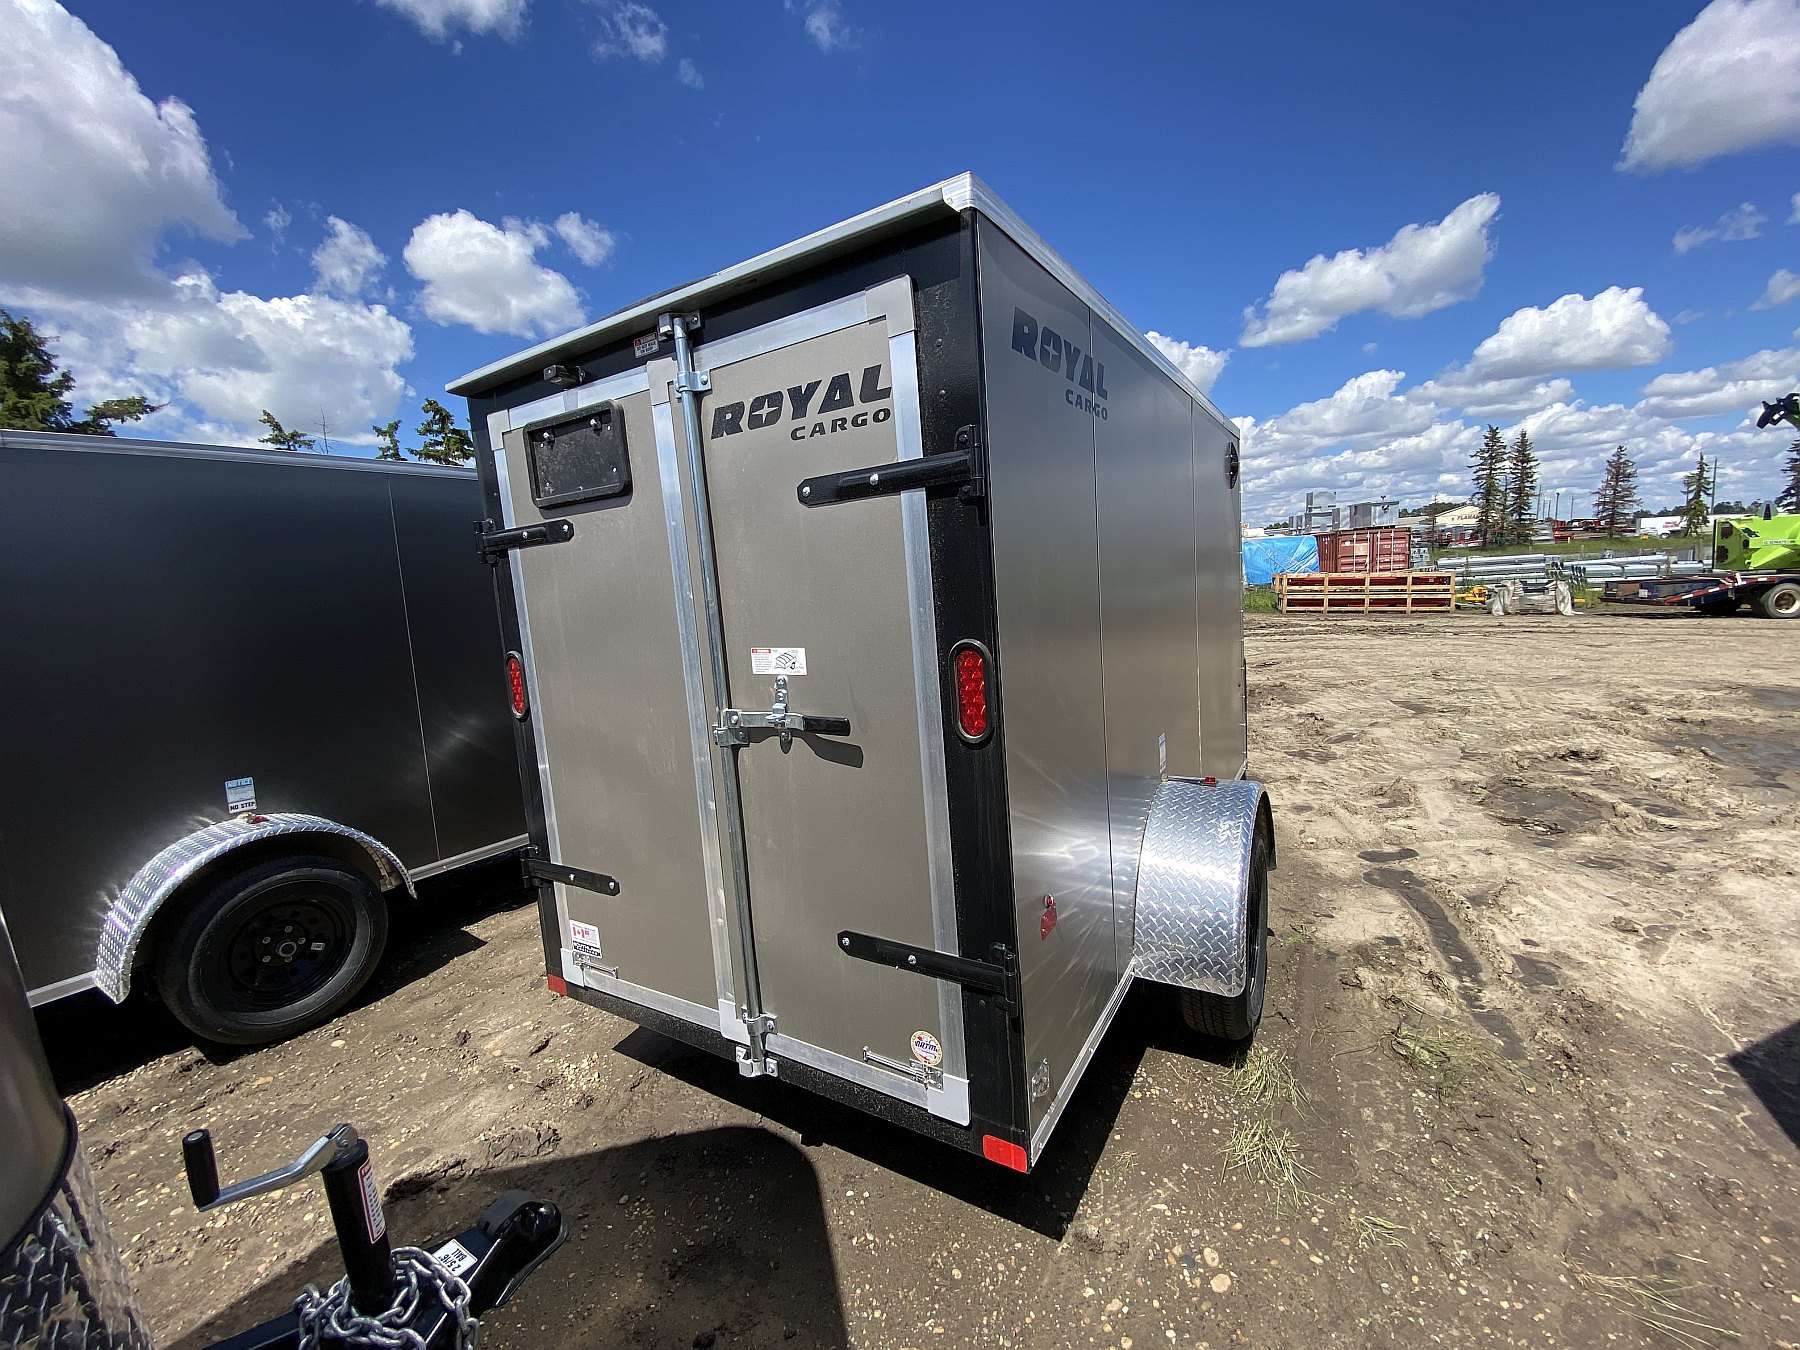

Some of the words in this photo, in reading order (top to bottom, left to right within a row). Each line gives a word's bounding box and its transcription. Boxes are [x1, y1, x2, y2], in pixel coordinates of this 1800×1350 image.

[1011, 306, 1108, 401] ROYAL
[711, 364, 892, 440] ROYAL
[1065, 388, 1108, 421] CARGO
[790, 407, 891, 441] CARGO
[451, 1248, 467, 1262] BALL
